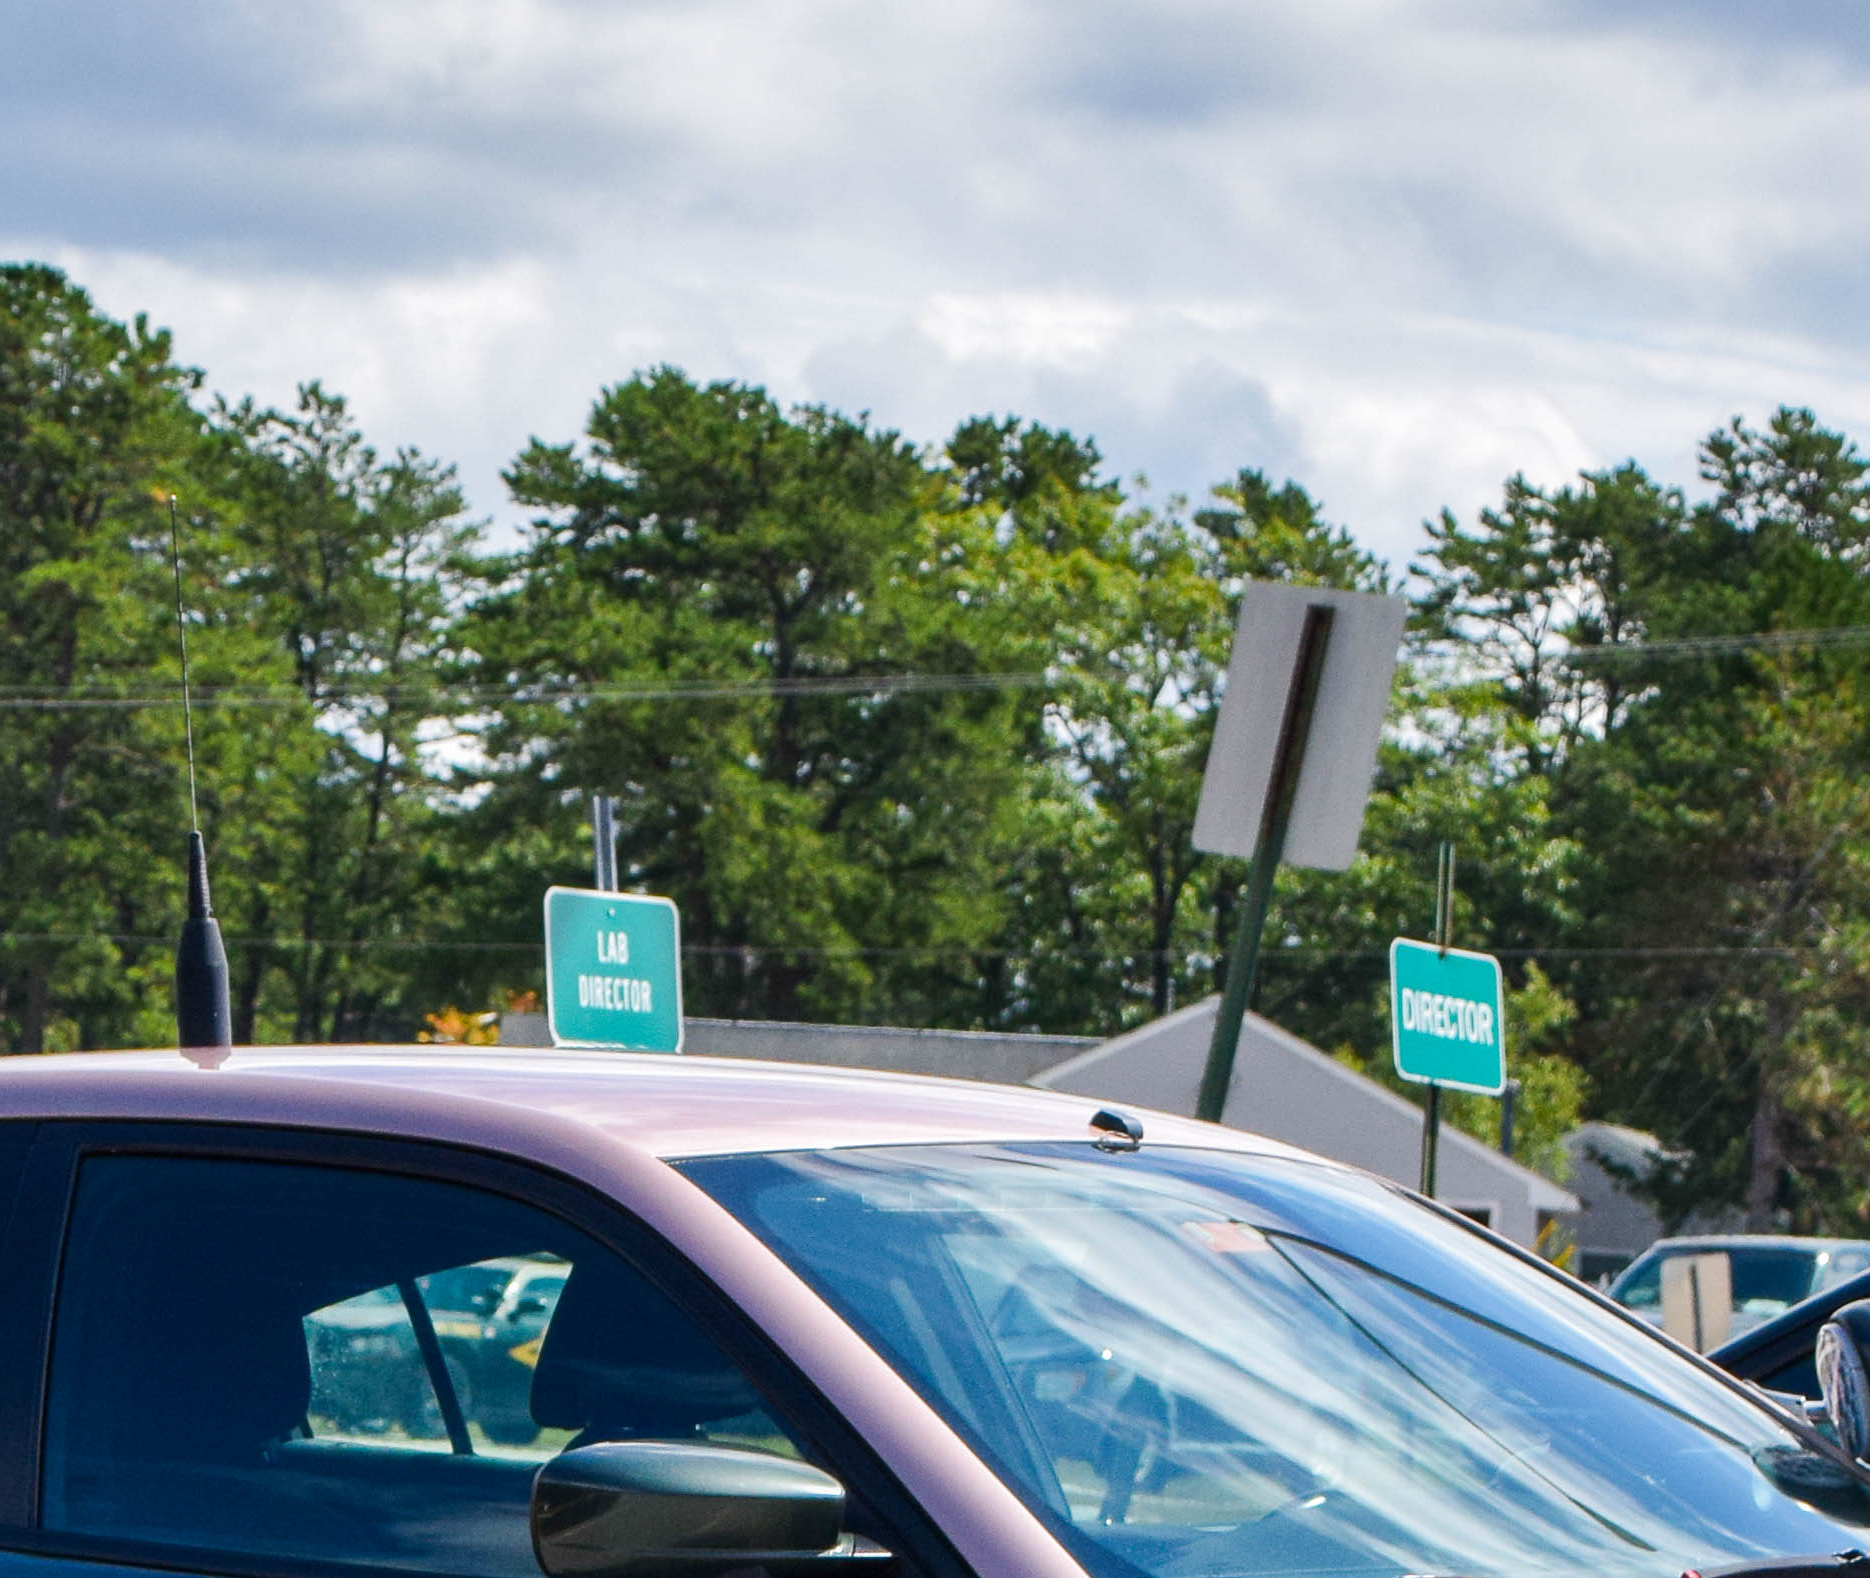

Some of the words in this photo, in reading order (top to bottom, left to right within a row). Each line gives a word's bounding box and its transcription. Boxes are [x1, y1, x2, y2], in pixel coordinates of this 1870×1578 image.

[597, 930, 629, 964] LAB
[578, 974, 653, 1013] DIRECTOR
[1402, 987, 1494, 1046] DIRECTOR
